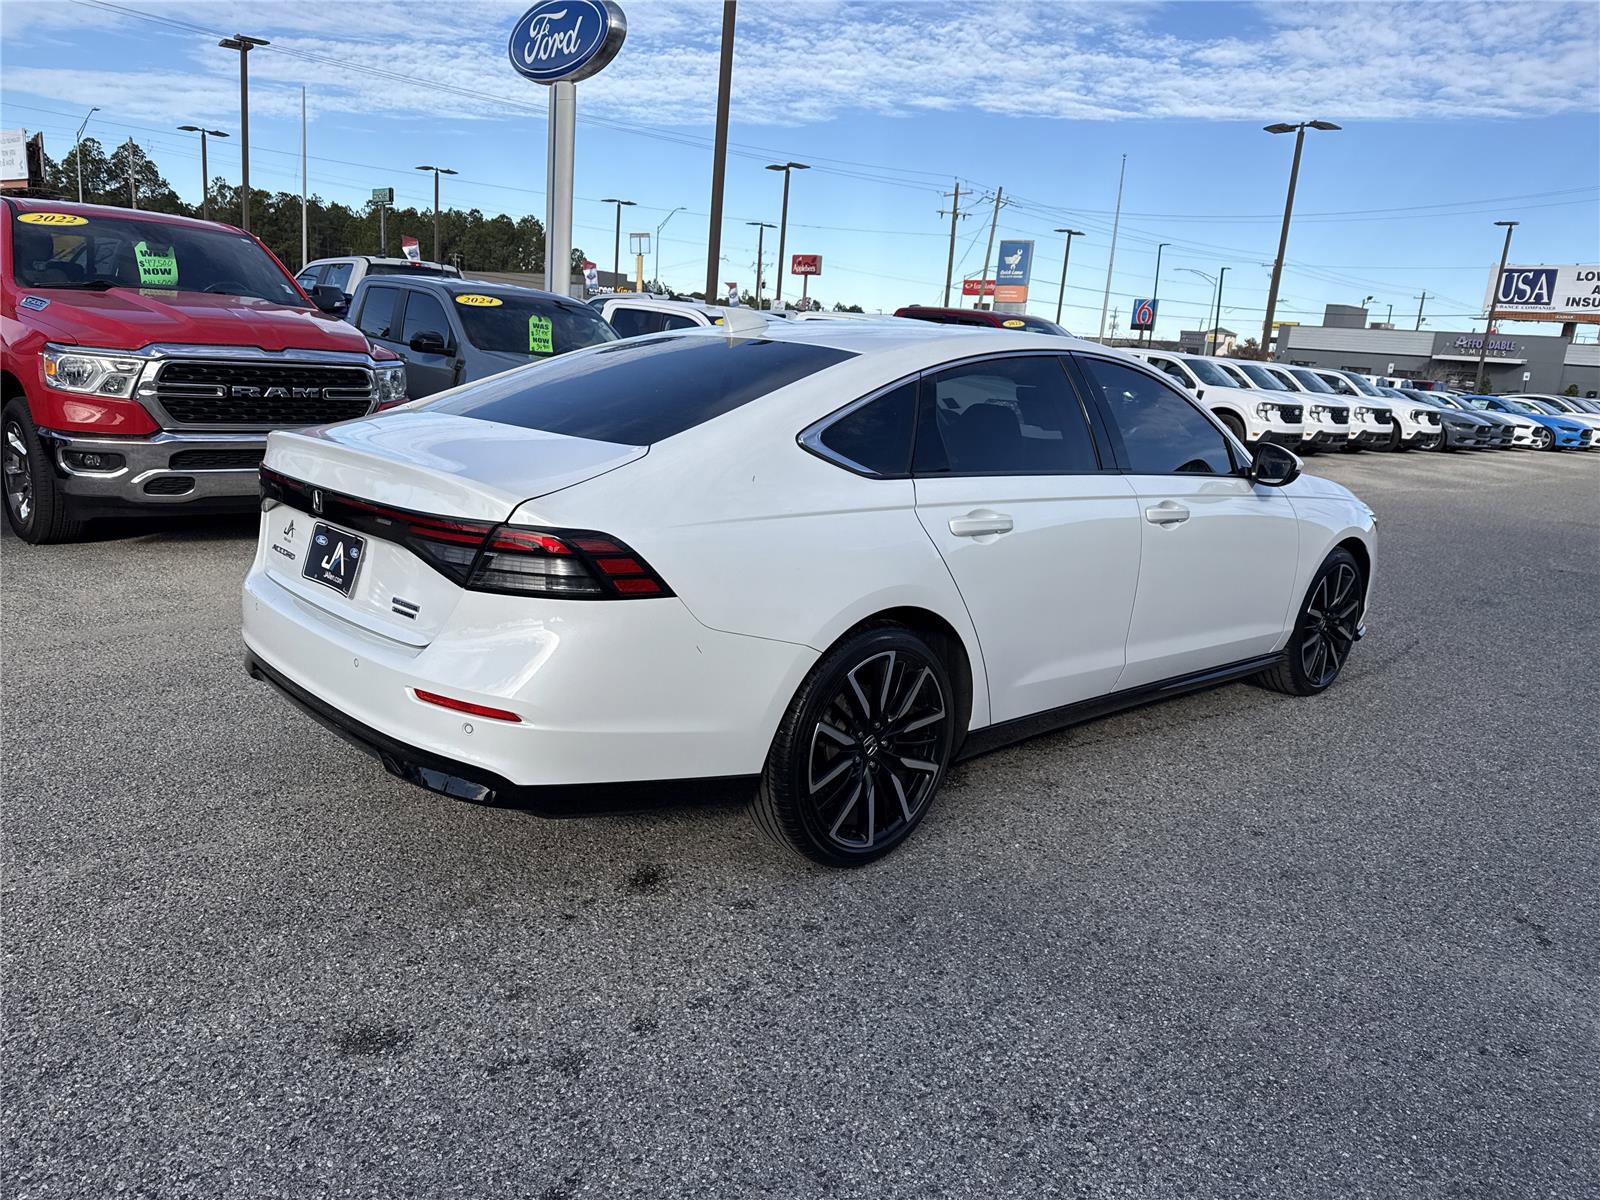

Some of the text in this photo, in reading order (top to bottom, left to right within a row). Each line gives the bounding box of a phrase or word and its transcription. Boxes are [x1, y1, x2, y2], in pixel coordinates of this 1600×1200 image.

[524, 8, 583, 64] Ford
[33, 213, 78, 224] 2022
[139, 249, 169, 258] WAS
[142, 267, 172, 276] NOW
[1498, 271, 1551, 304] USA
[463, 296, 495, 305] 2024
[1136, 298, 1153, 325] 6
[532, 322, 550, 331] WAS
[532, 336, 550, 345] NOW
[1454, 336, 1517, 351] AFFODABLE
[1460, 347, 1507, 357] SMILES
[231, 385, 320, 399] RAM
[271, 543, 297, 561] ACCORD
